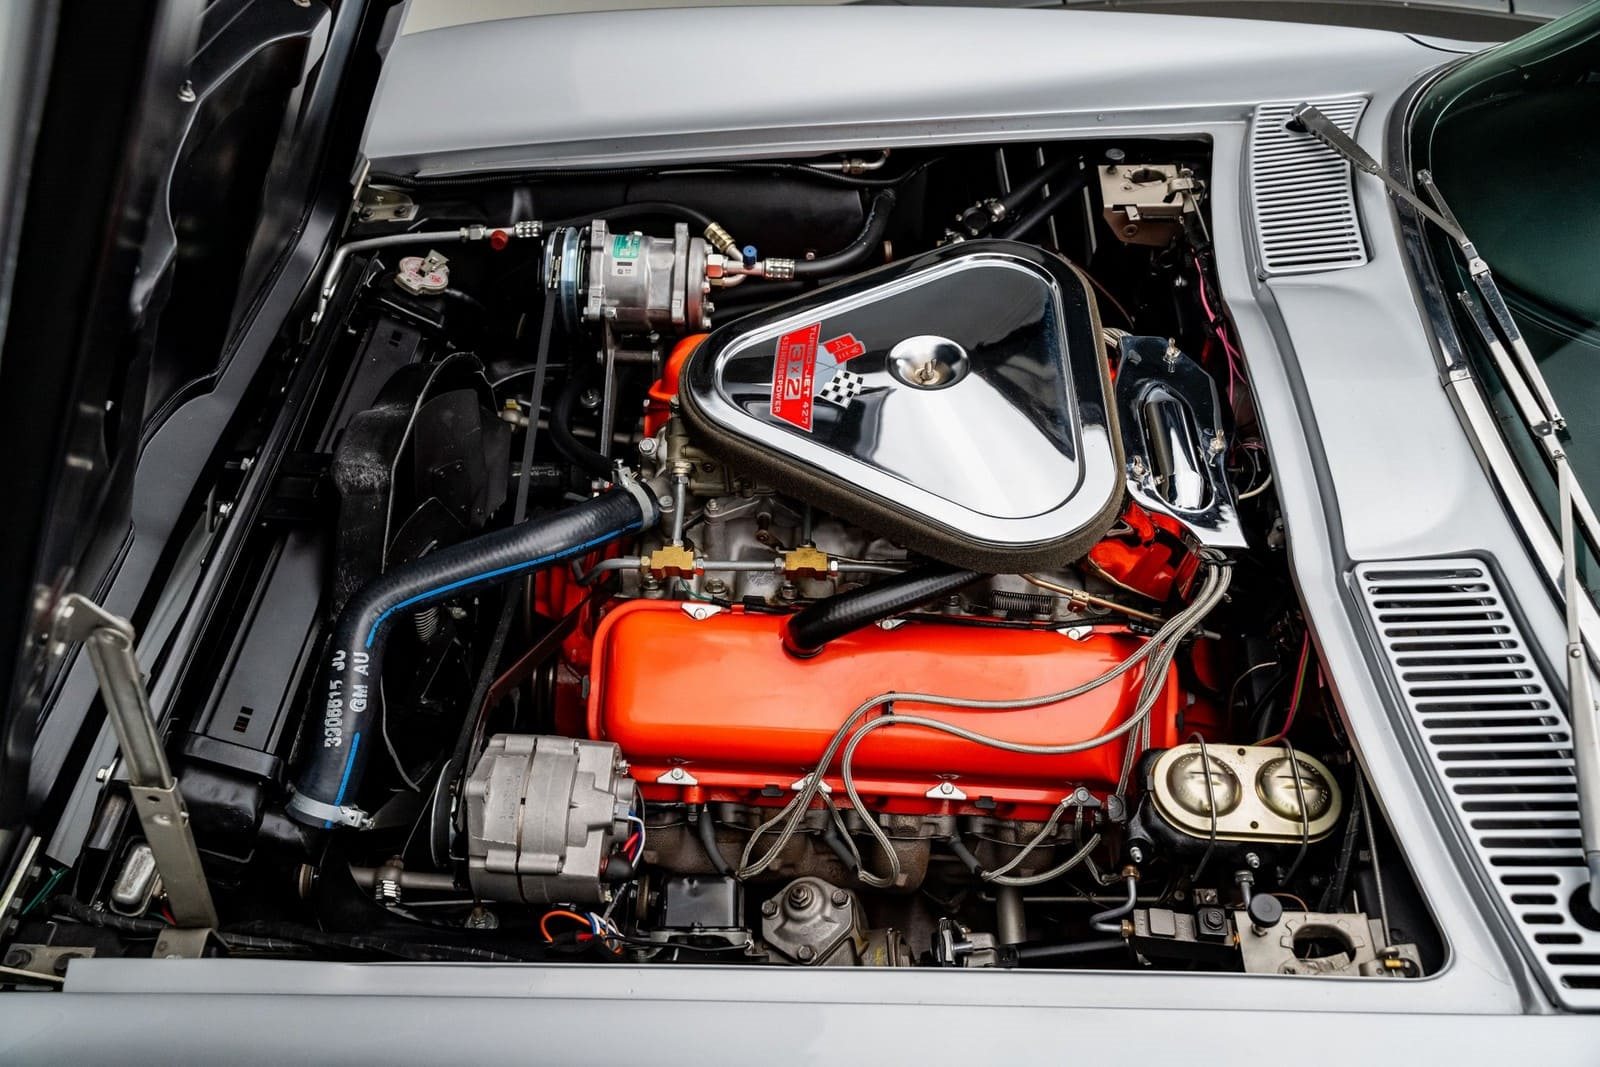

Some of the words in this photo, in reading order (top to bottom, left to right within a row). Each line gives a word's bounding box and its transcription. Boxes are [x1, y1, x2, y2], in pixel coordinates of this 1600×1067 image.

[803, 326, 817, 397] TURBO-JET
[802, 401, 810, 424] 427
[353, 652, 370, 676] AU
[349, 685, 368, 712] GM
